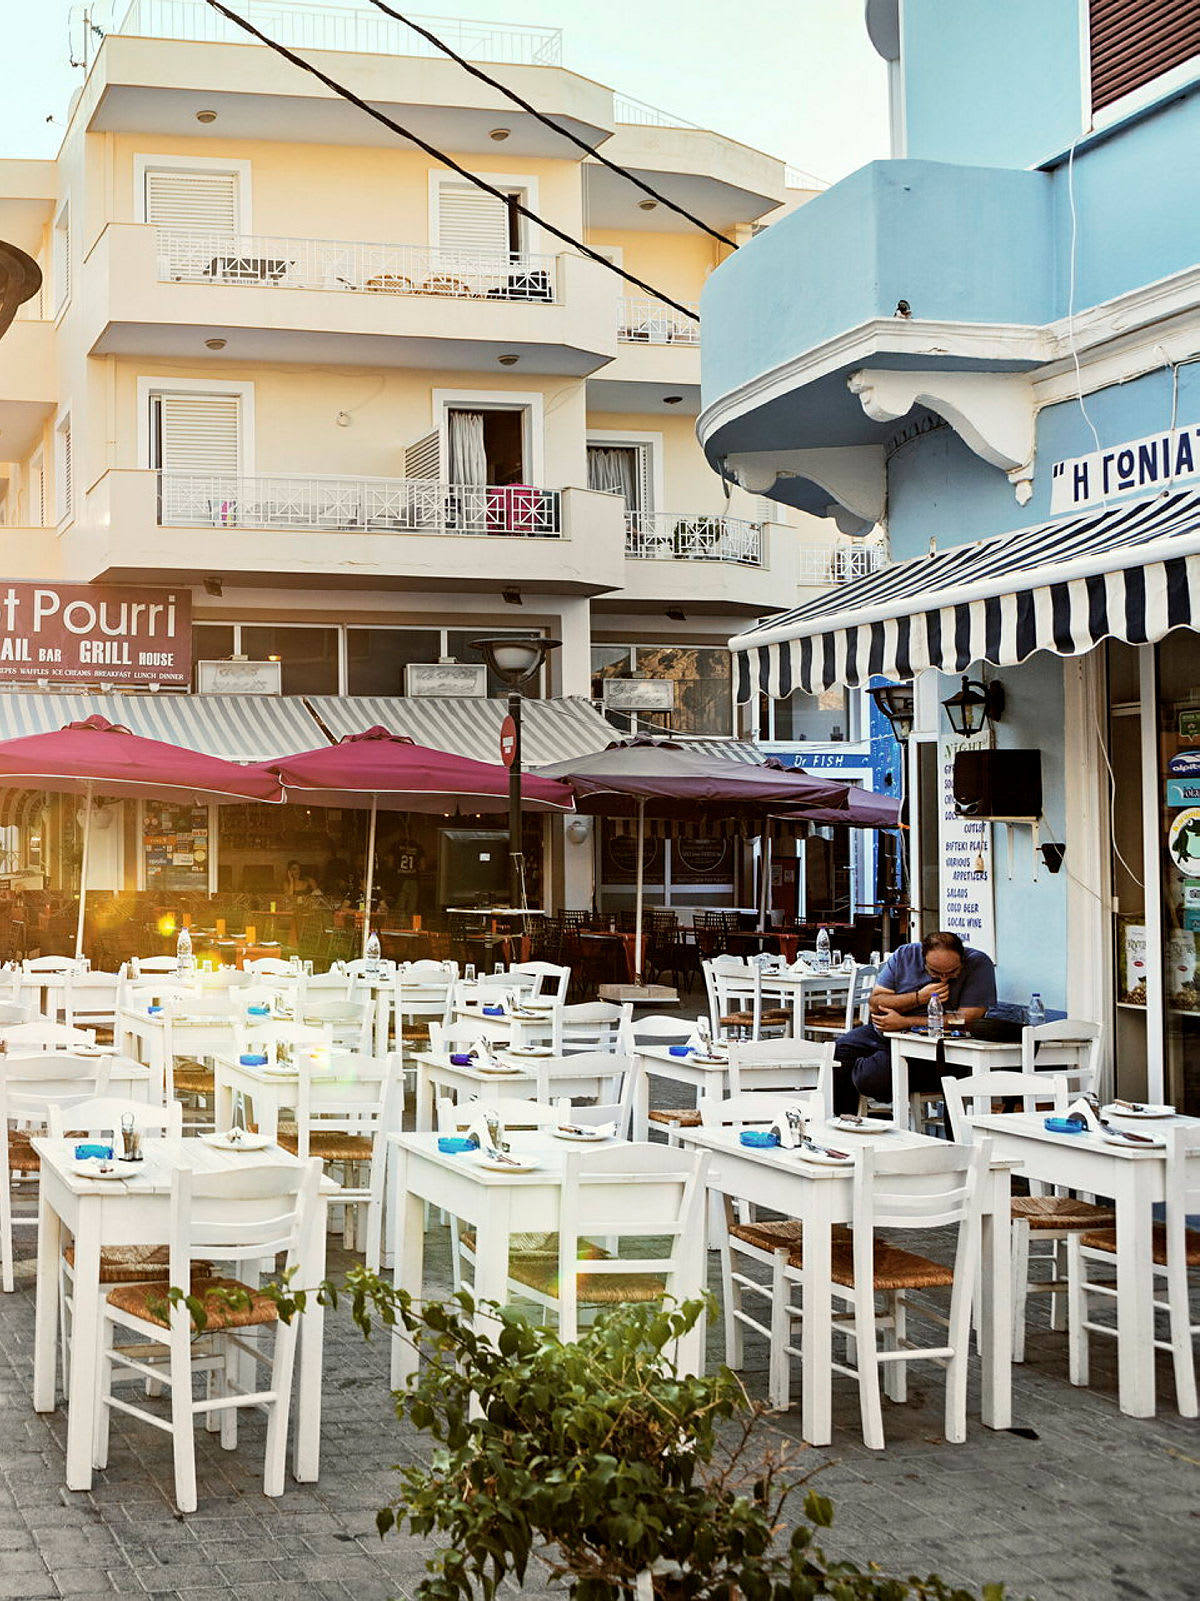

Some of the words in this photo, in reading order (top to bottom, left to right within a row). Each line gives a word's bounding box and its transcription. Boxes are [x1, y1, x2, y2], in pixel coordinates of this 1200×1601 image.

[33, 589, 176, 637] Pourri
[39, 648, 62, 663] BAR
[79, 640, 133, 665] GRILL
[138, 652, 175, 667] HOUSE
[19, 668, 50, 676] WAFFLES
[52, 668, 63, 676] ICE
[64, 669, 92, 677] CREAMS
[93, 670, 132, 679] BREAKFAST
[133, 672, 157, 680] LUNCH
[158, 672, 185, 681] DINNER
[794, 754, 807, 768] Dr
[813, 754, 845, 768] FISH
[945, 841, 968, 852] BIFTEKI
[969, 841, 989, 852] PLATE
[400, 854, 414, 870] 21
[945, 857, 971, 868] VARIOUS
[946, 888, 969, 899] SALADS
[946, 902, 961, 913] COLD
[963, 903, 980, 914] BEER
[947, 917, 965, 928] LOCAL
[966, 918, 983, 929] WINE
